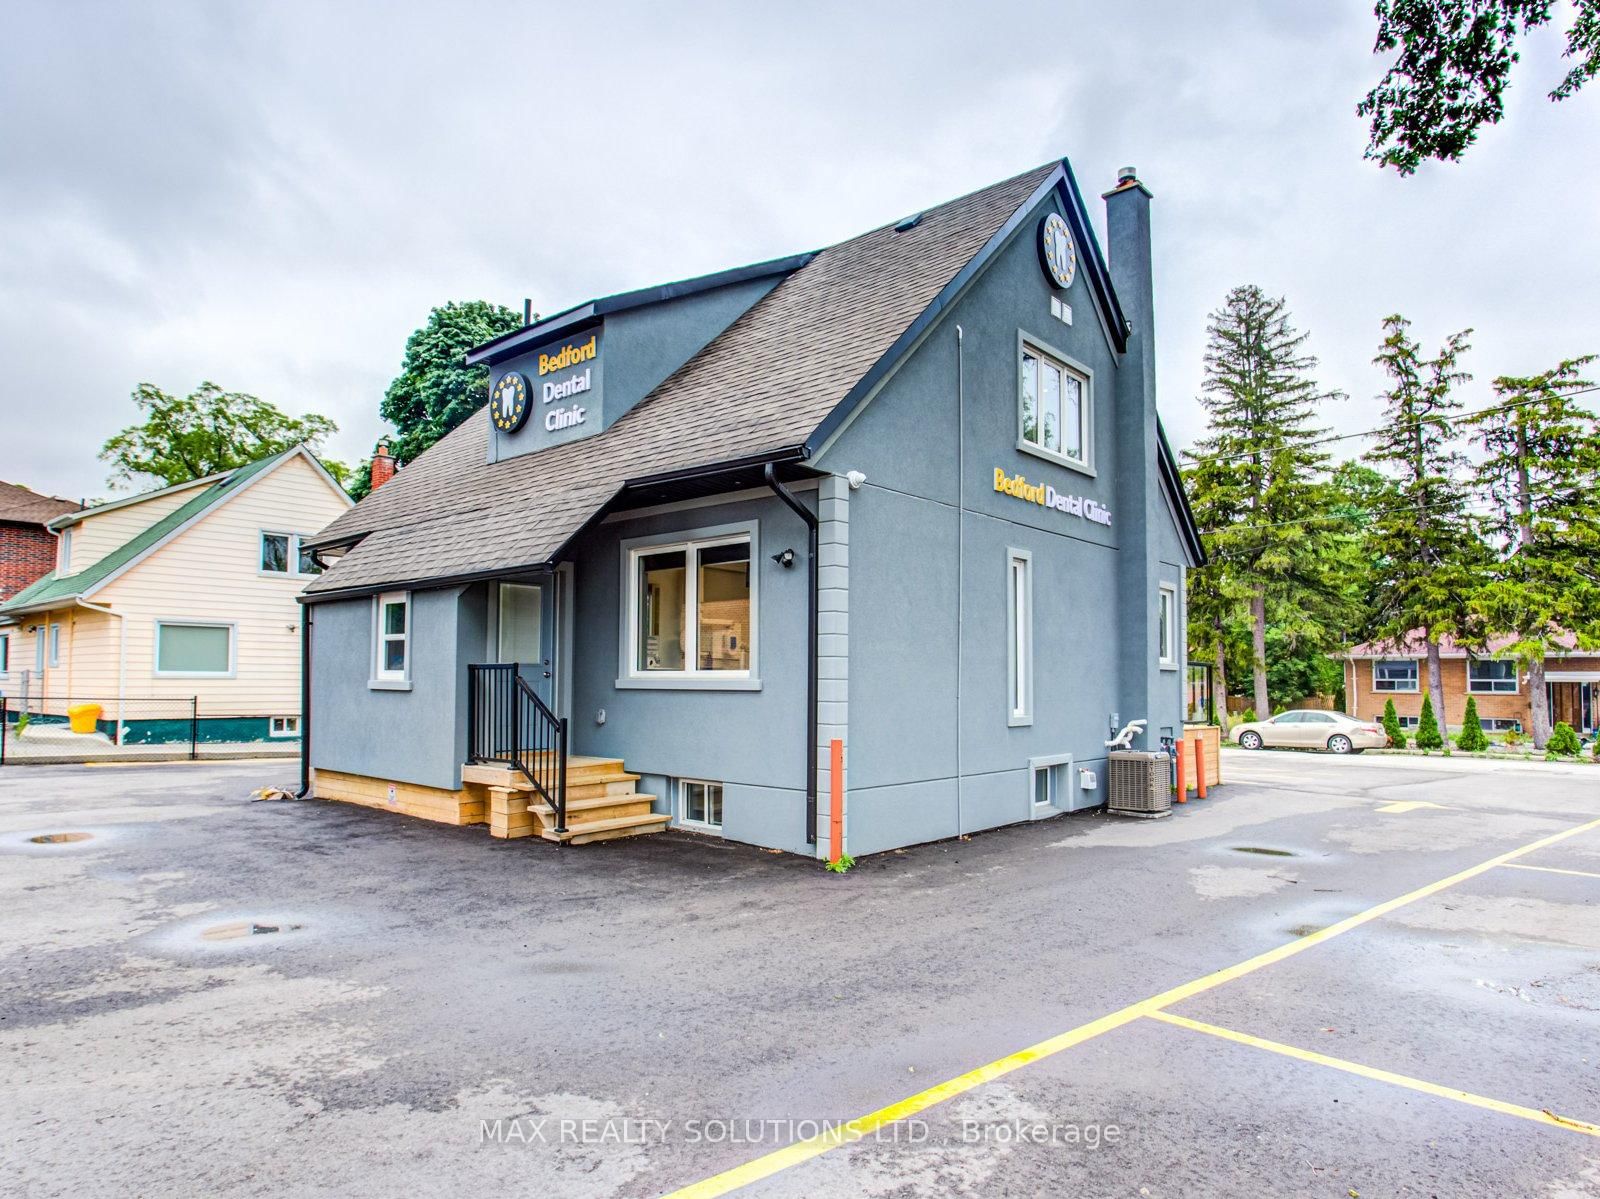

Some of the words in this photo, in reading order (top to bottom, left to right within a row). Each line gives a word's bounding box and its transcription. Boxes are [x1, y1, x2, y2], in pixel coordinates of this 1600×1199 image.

[538, 335, 597, 376] Bedford
[543, 368, 591, 403] Dental
[545, 404, 586, 431] Clinic
[993, 467, 1045, 506] Bedford
[1045, 485, 1083, 518] Dental
[1083, 499, 1111, 526] Clinic
